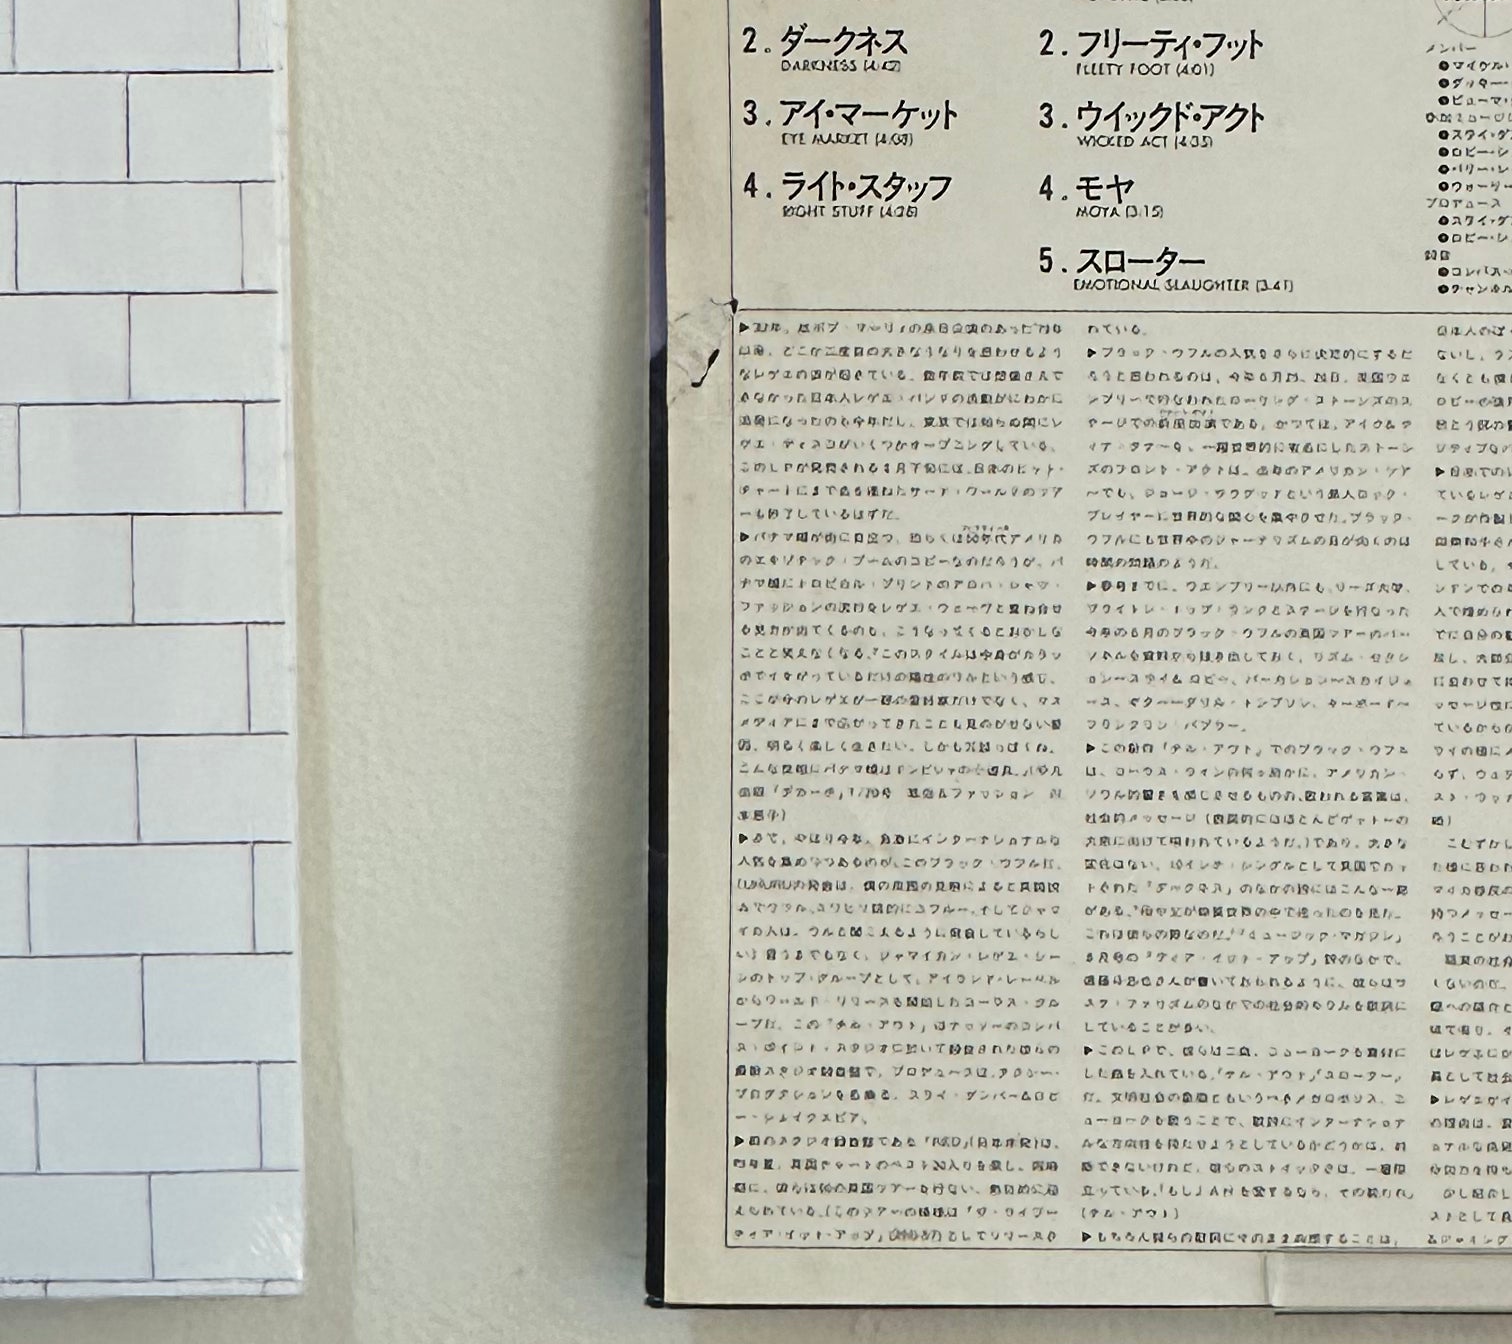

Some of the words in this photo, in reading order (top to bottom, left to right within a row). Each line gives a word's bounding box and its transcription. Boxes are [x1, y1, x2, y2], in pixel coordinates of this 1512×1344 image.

[781, 22, 908, 57] ダークネス
[1078, 28, 1263, 61] フリーティ・フット
[780, 98, 958, 130] アイ・マーケット
[1140, 136, 1168, 148] ACT
[782, 170, 952, 203] ライト・スタッフ
[1076, 174, 1135, 204] モヤ
[1076, 206, 1120, 218] MOYA
[1077, 247, 1206, 277] スローター
[1164, 279, 1249, 292] SLAUGHTER
